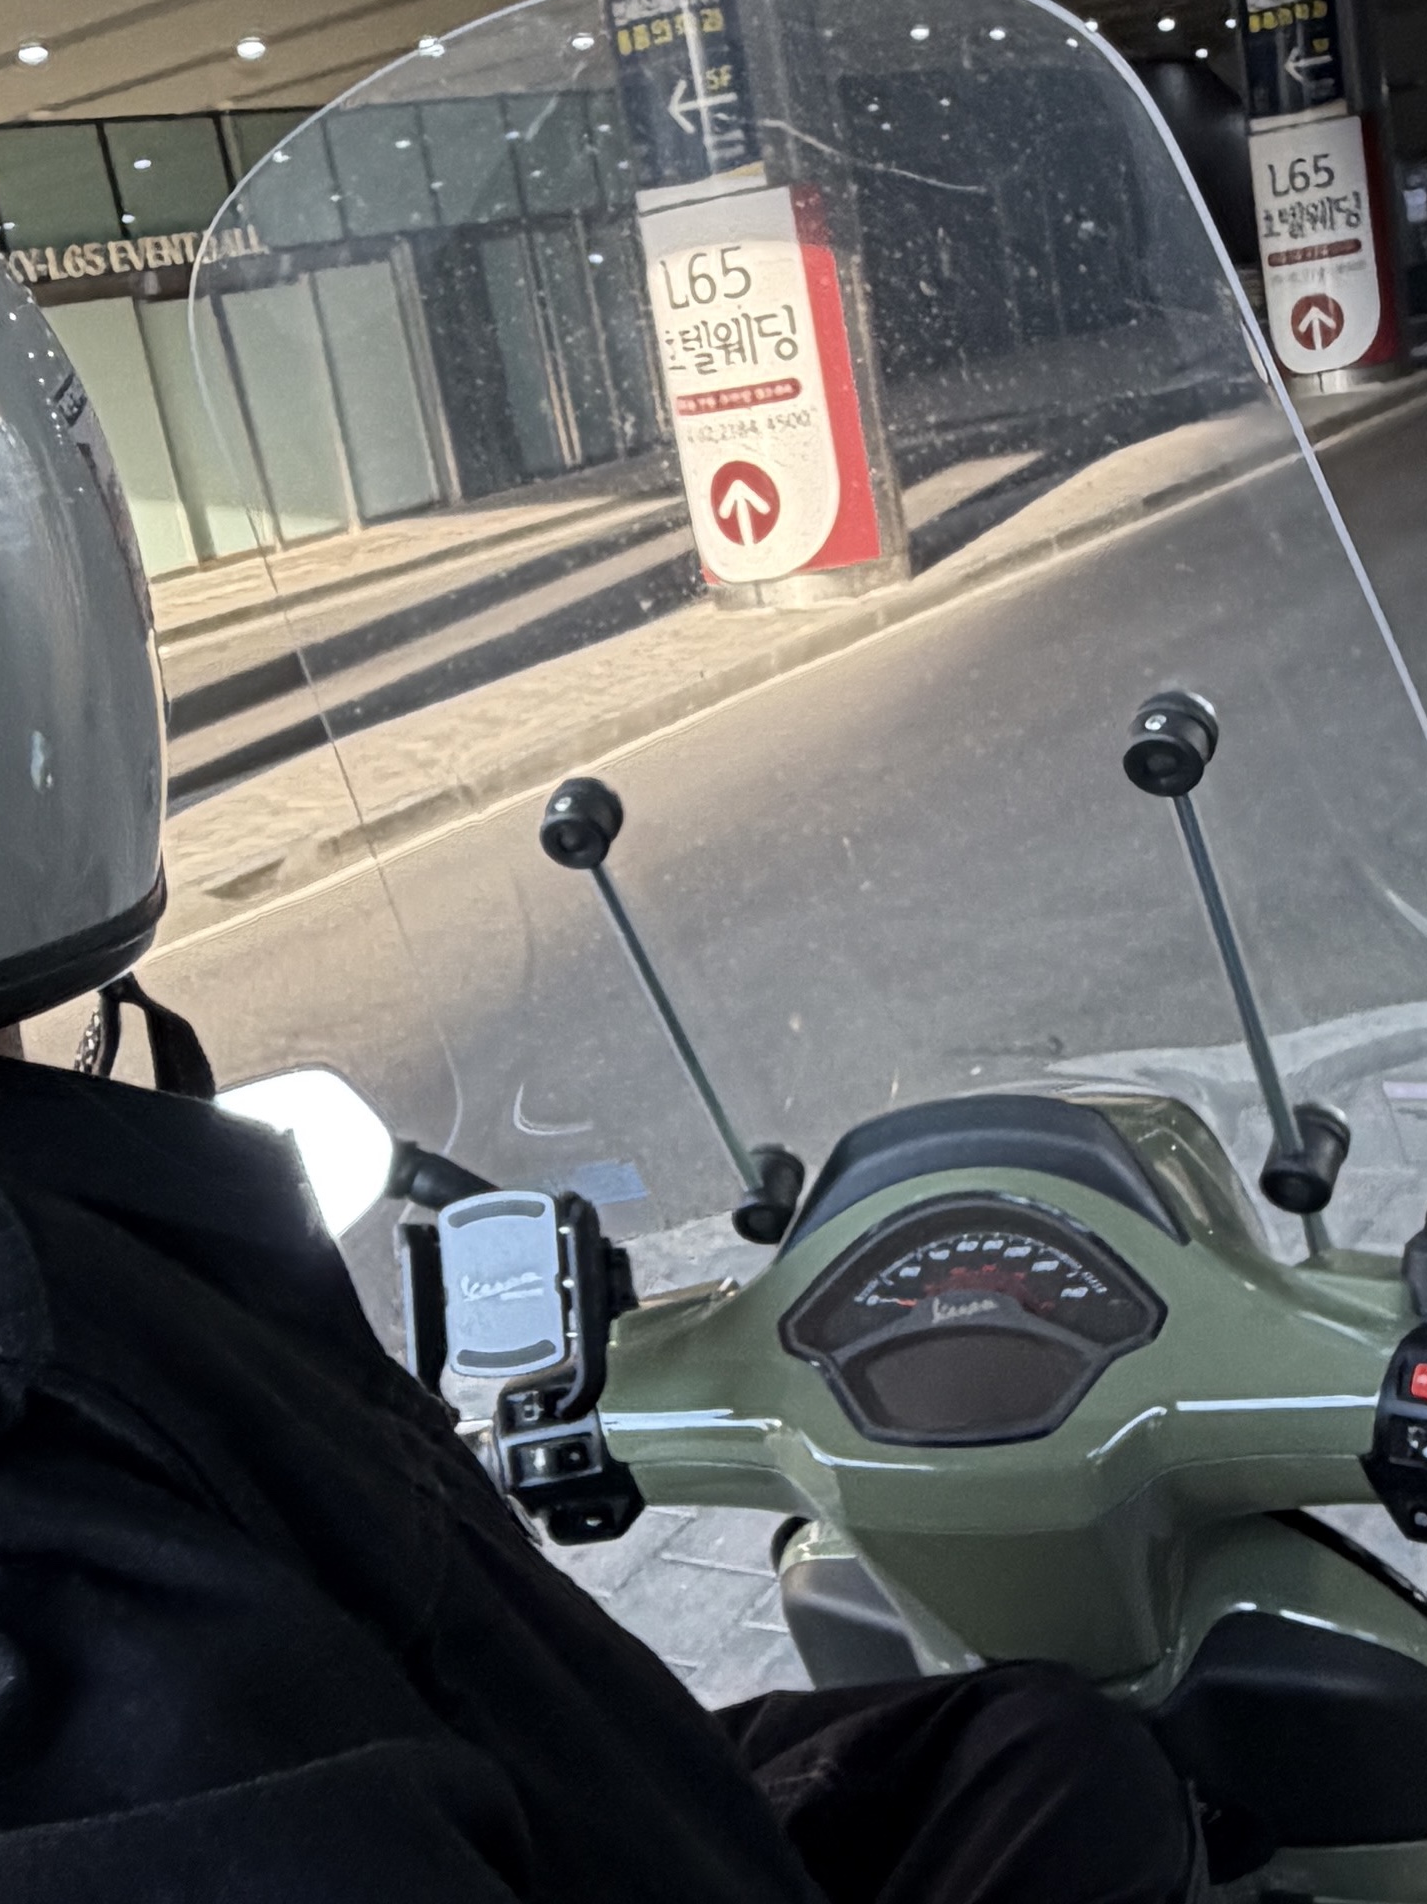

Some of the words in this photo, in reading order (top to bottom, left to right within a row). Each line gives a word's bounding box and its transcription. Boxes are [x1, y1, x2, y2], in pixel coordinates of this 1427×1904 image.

[1267, 153, 1335, 197] L65
[107, 232, 198, 274] EVENT
[659, 245, 753, 309] L65
